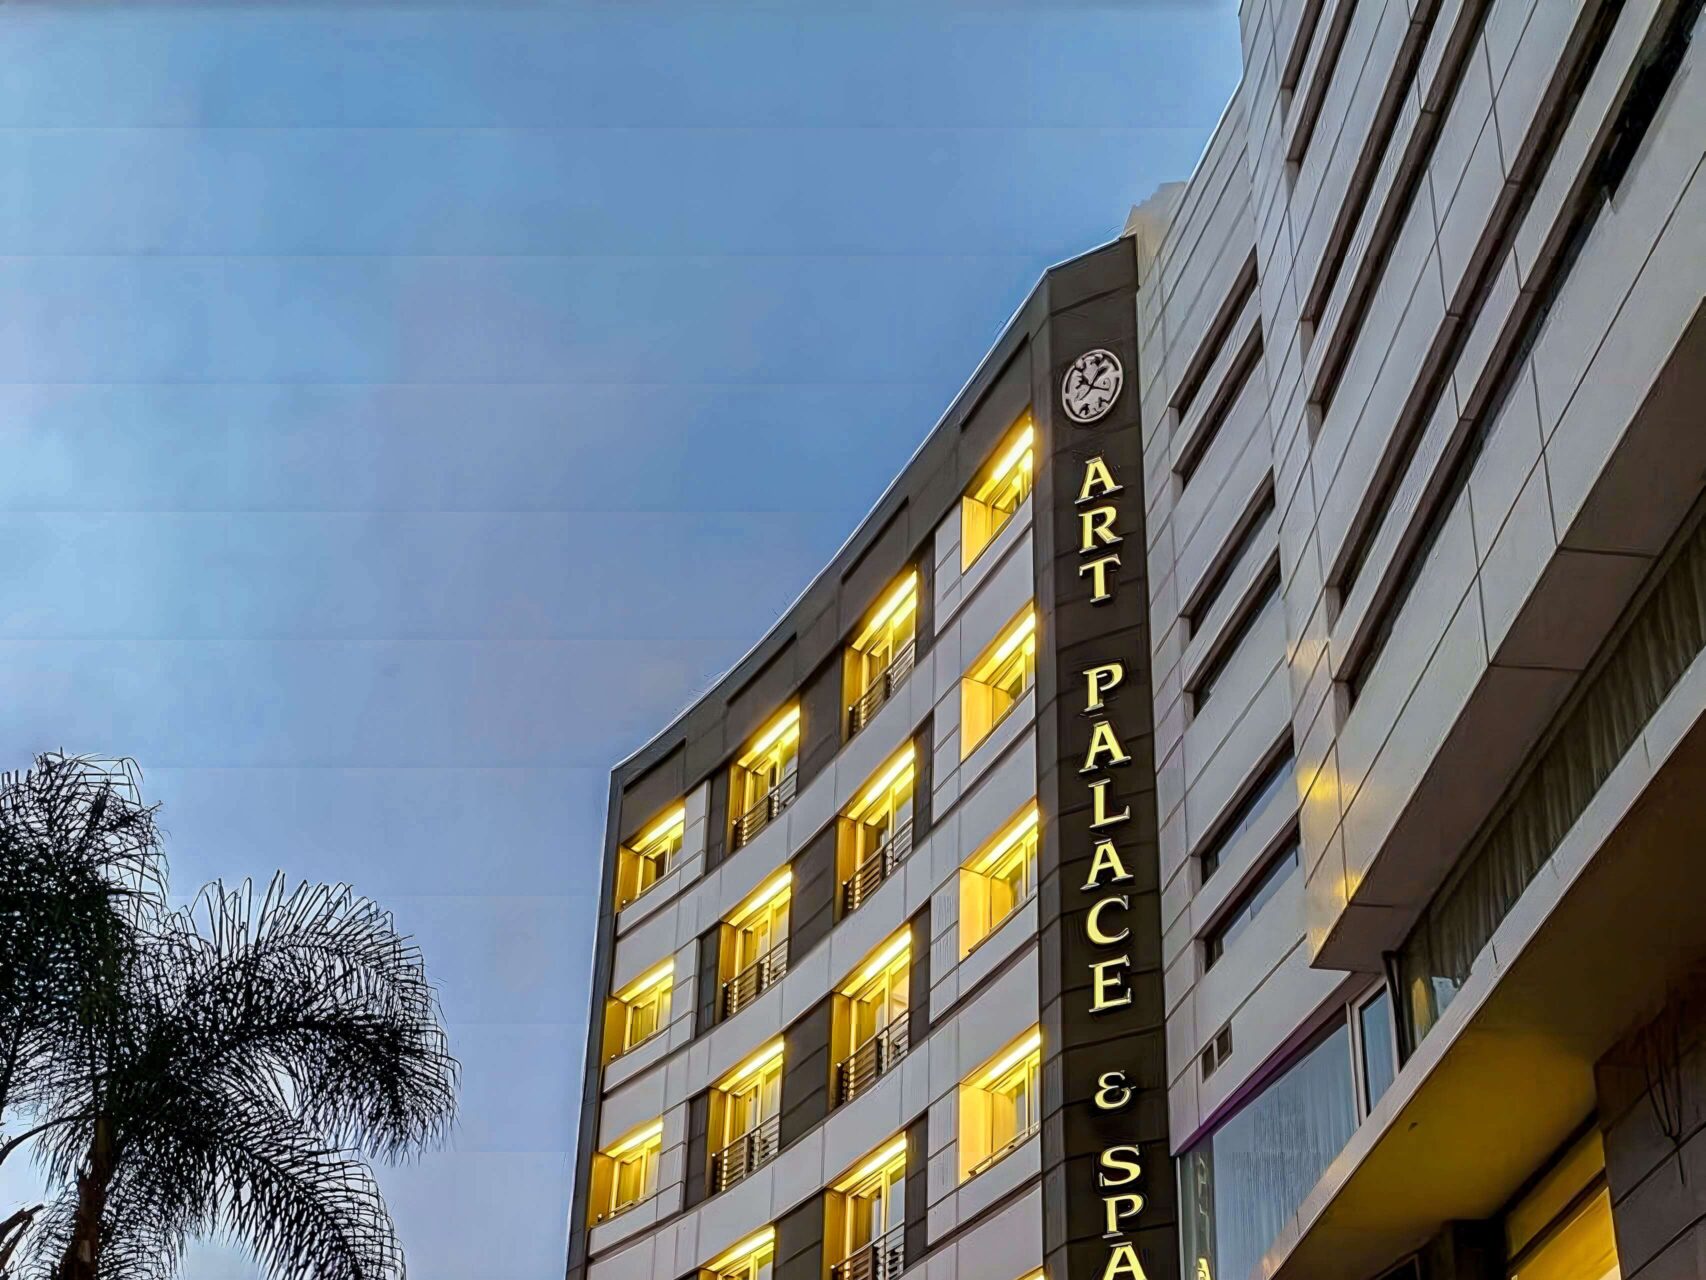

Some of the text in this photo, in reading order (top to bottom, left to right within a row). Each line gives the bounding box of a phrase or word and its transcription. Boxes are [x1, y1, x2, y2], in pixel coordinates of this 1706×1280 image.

[1074, 455, 1124, 603] ART
[1079, 661, 1134, 1013] PALACE
[1094, 1070, 1136, 1110] &
